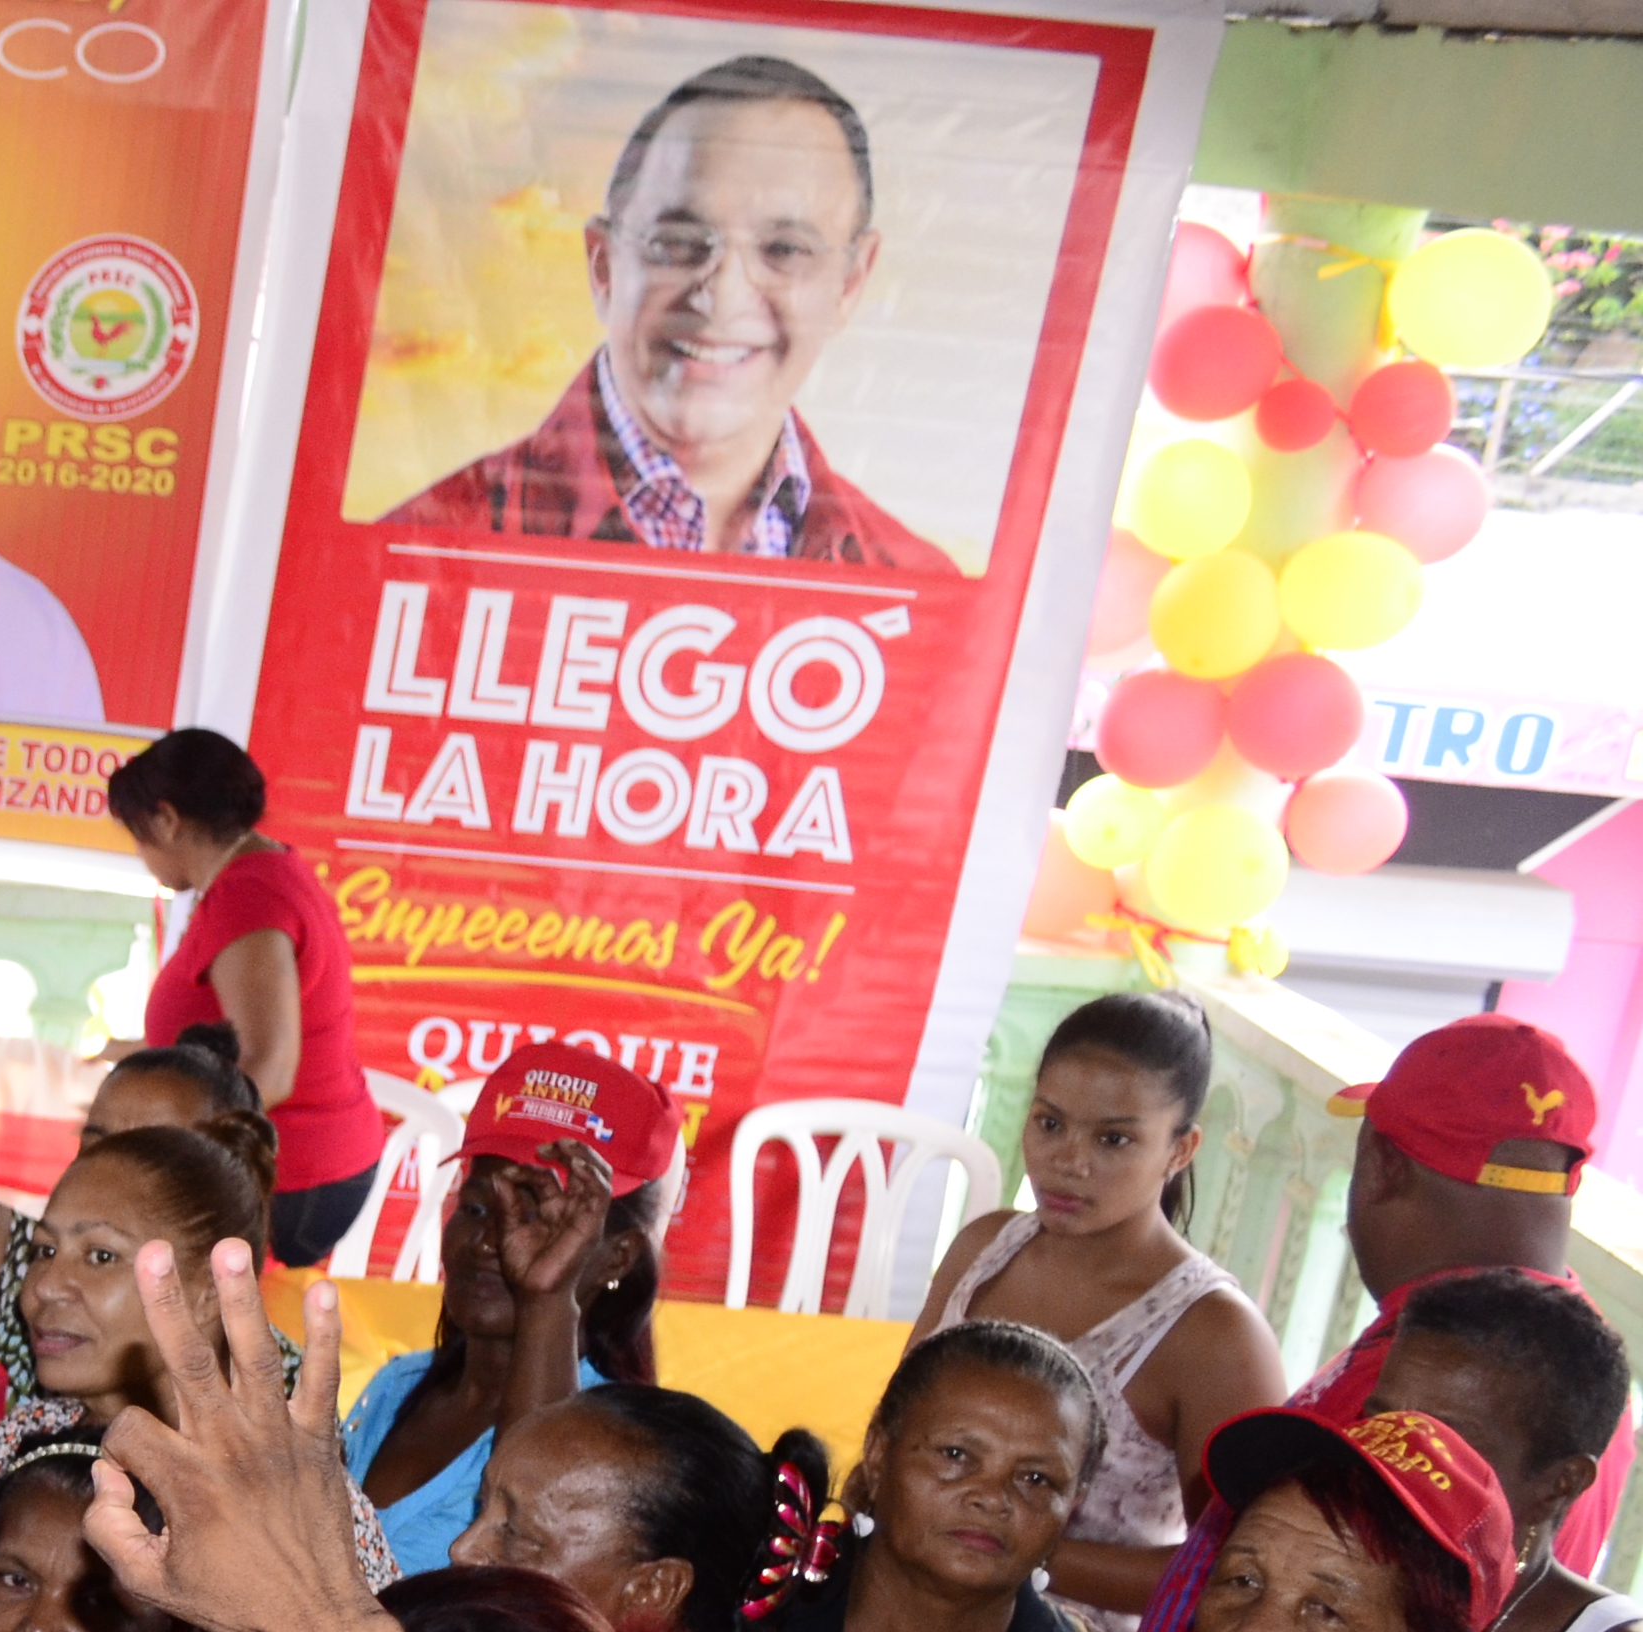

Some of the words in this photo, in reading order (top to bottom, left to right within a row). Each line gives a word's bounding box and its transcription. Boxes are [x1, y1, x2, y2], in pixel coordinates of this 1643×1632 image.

[3, 418, 180, 468] PRSC
[363, 580, 911, 753] LLEGÓ
[22, 740, 138, 779] TODO
[344, 724, 492, 830] LA
[512, 739, 855, 864] HORA
[317, 862, 679, 970] Empecemos
[699, 898, 847, 990] Ya!
[525, 1069, 599, 1098] QUIQUE
